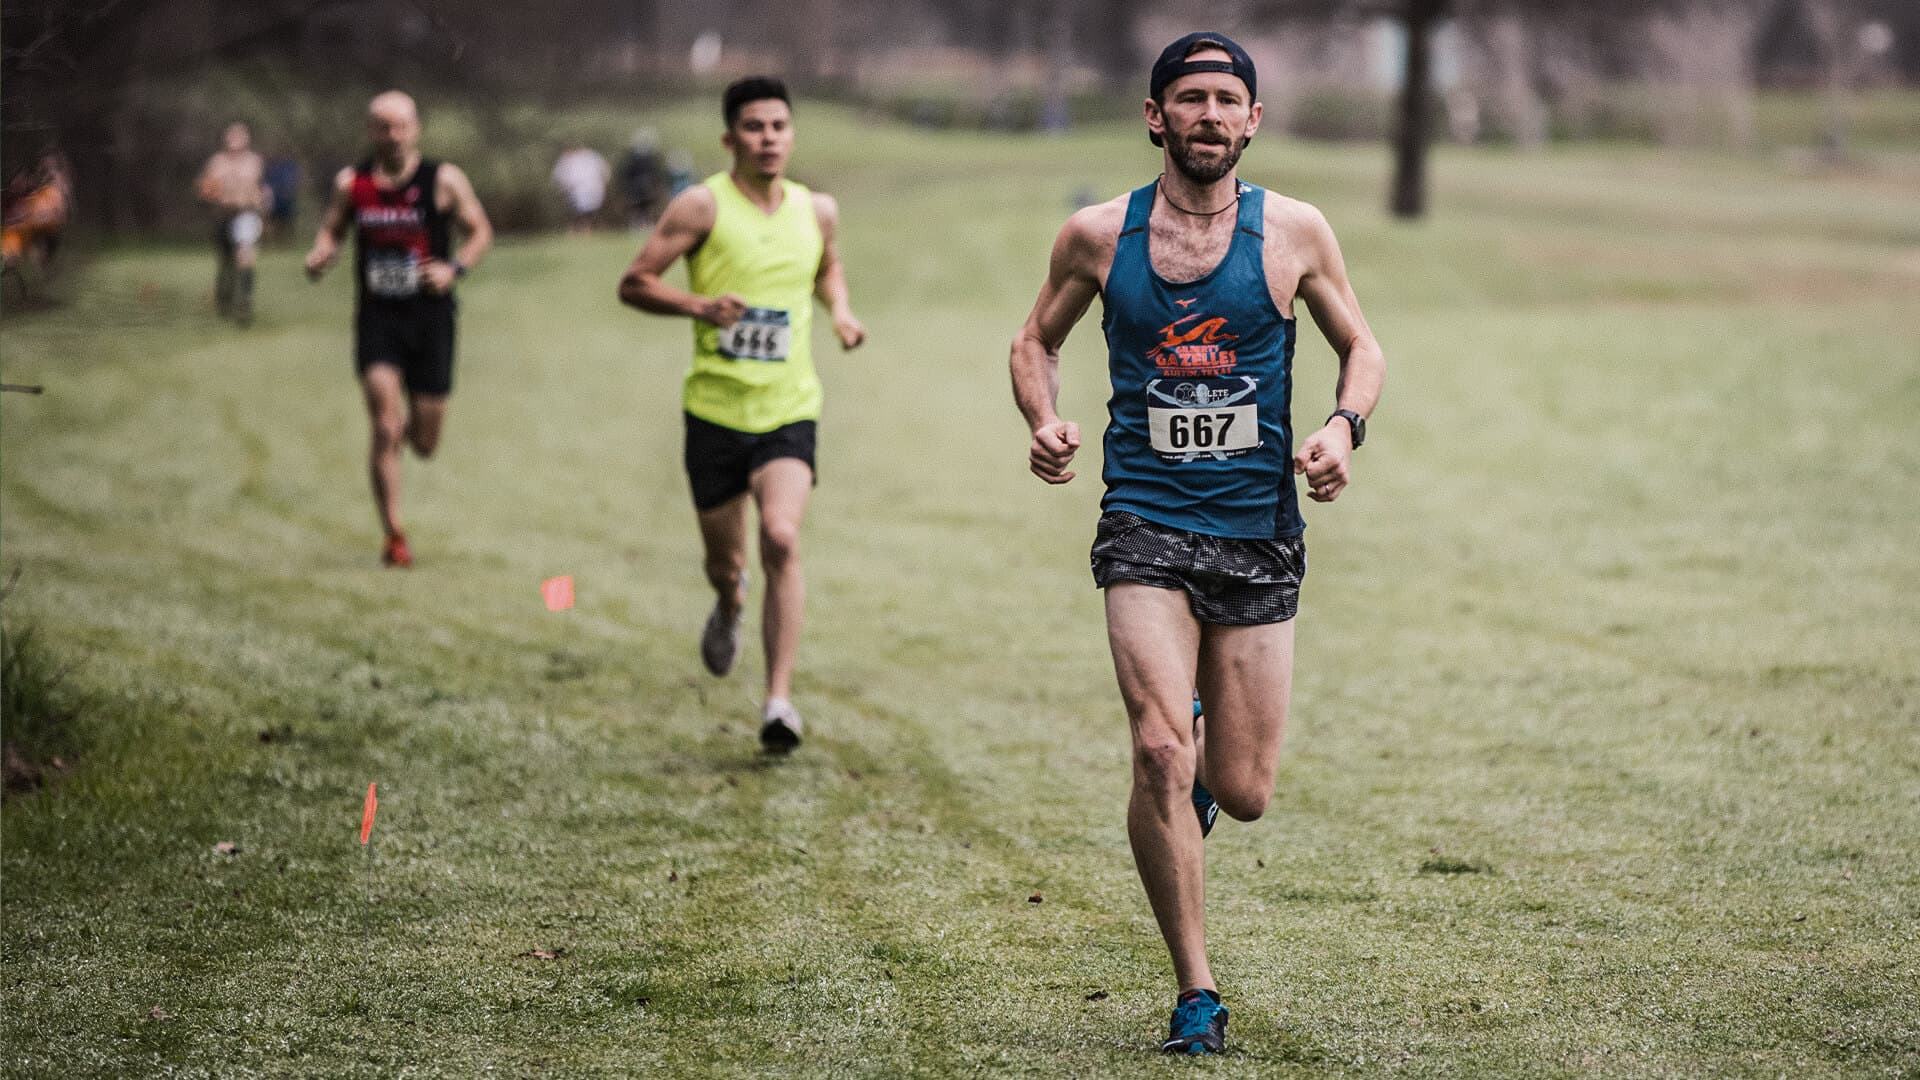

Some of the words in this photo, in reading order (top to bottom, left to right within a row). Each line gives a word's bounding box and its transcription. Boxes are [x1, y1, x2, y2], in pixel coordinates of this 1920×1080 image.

[733, 328, 777, 352] 666
[1155, 350, 1236, 366] GAZELLES
[1169, 413, 1235, 448] 667
